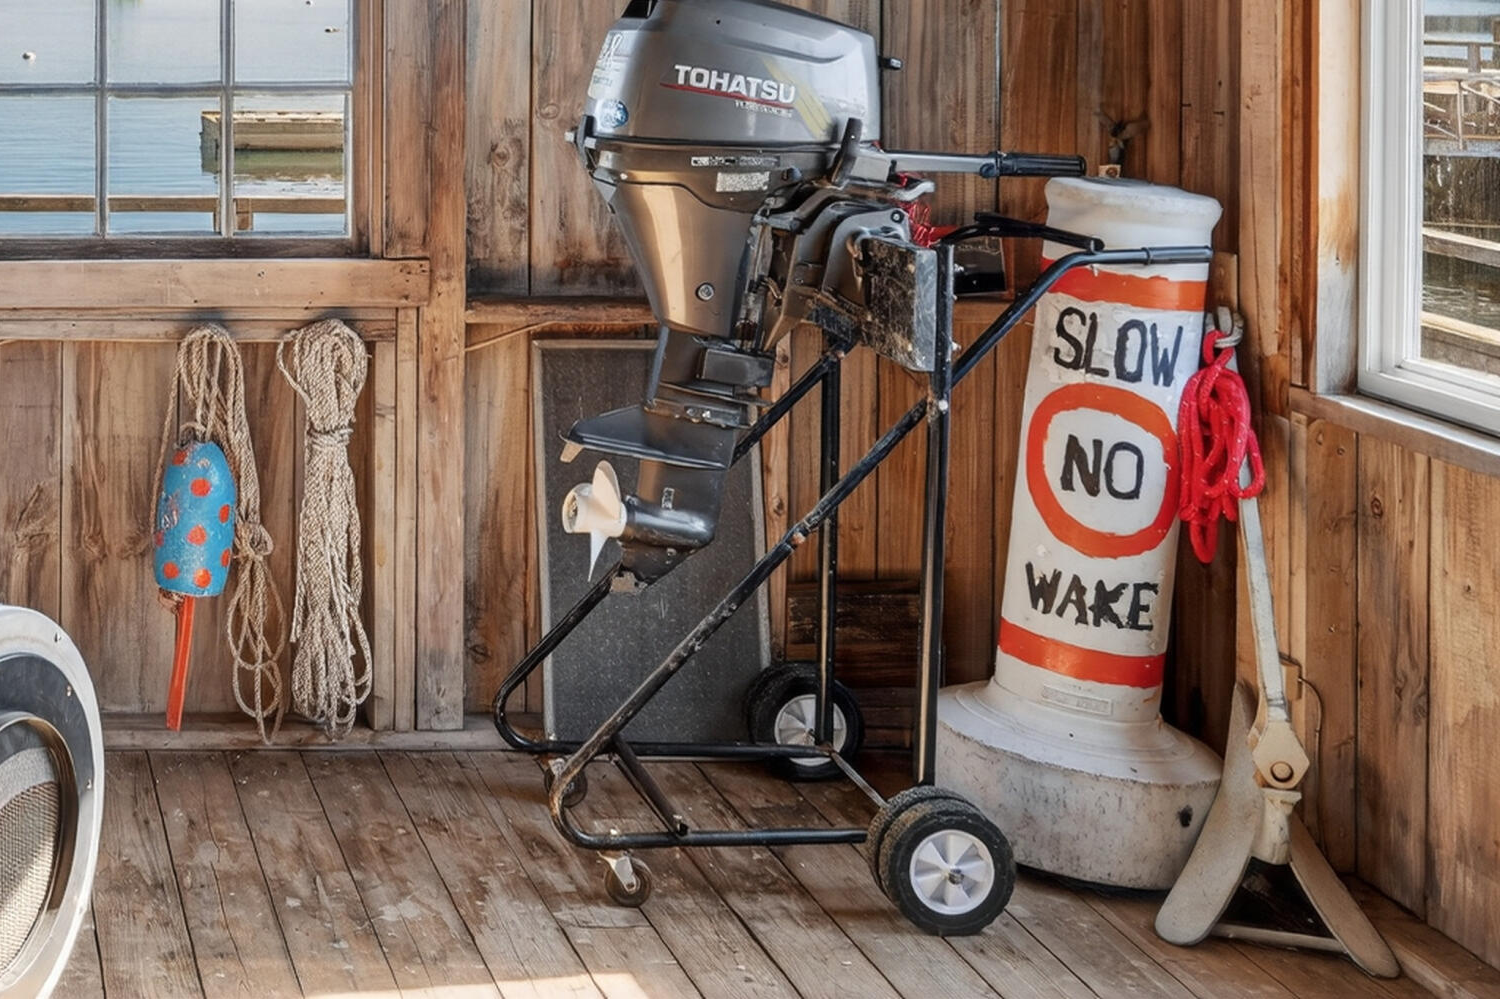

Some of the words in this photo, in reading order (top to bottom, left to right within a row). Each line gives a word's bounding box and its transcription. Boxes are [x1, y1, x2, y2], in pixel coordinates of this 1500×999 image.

[674, 63, 797, 104] TOHATSU
[1053, 306, 1184, 388] SLOW
[1060, 434, 1145, 500] NO
[1024, 561, 1159, 632] WAKE
